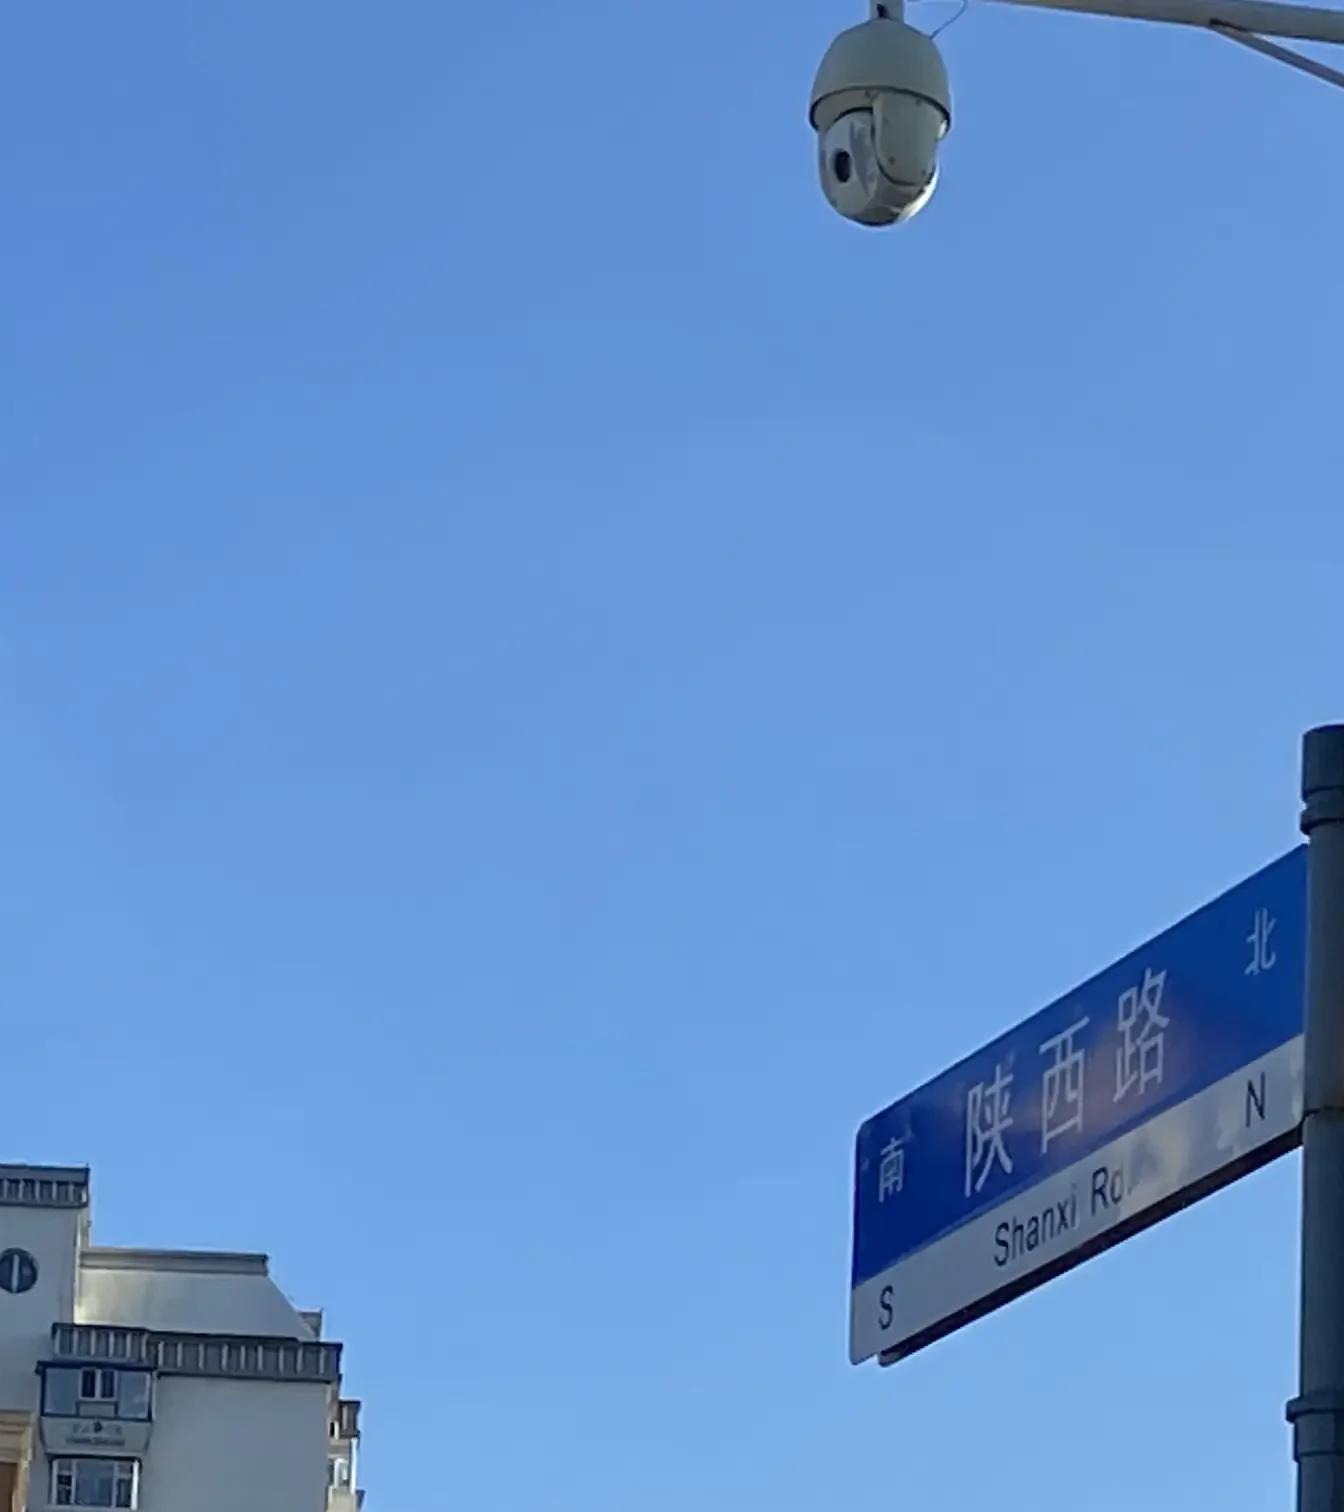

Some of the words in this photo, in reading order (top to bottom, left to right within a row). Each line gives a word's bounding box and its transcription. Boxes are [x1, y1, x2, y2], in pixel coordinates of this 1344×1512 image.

[877, 1137, 906, 1203] 南
[963, 968, 1170, 1198] 陕西路
[1244, 907, 1277, 976] 北
[877, 1284, 895, 1331] S
[992, 1182, 1078, 1267] Shanxi
[1244, 1072, 1267, 1129] N
